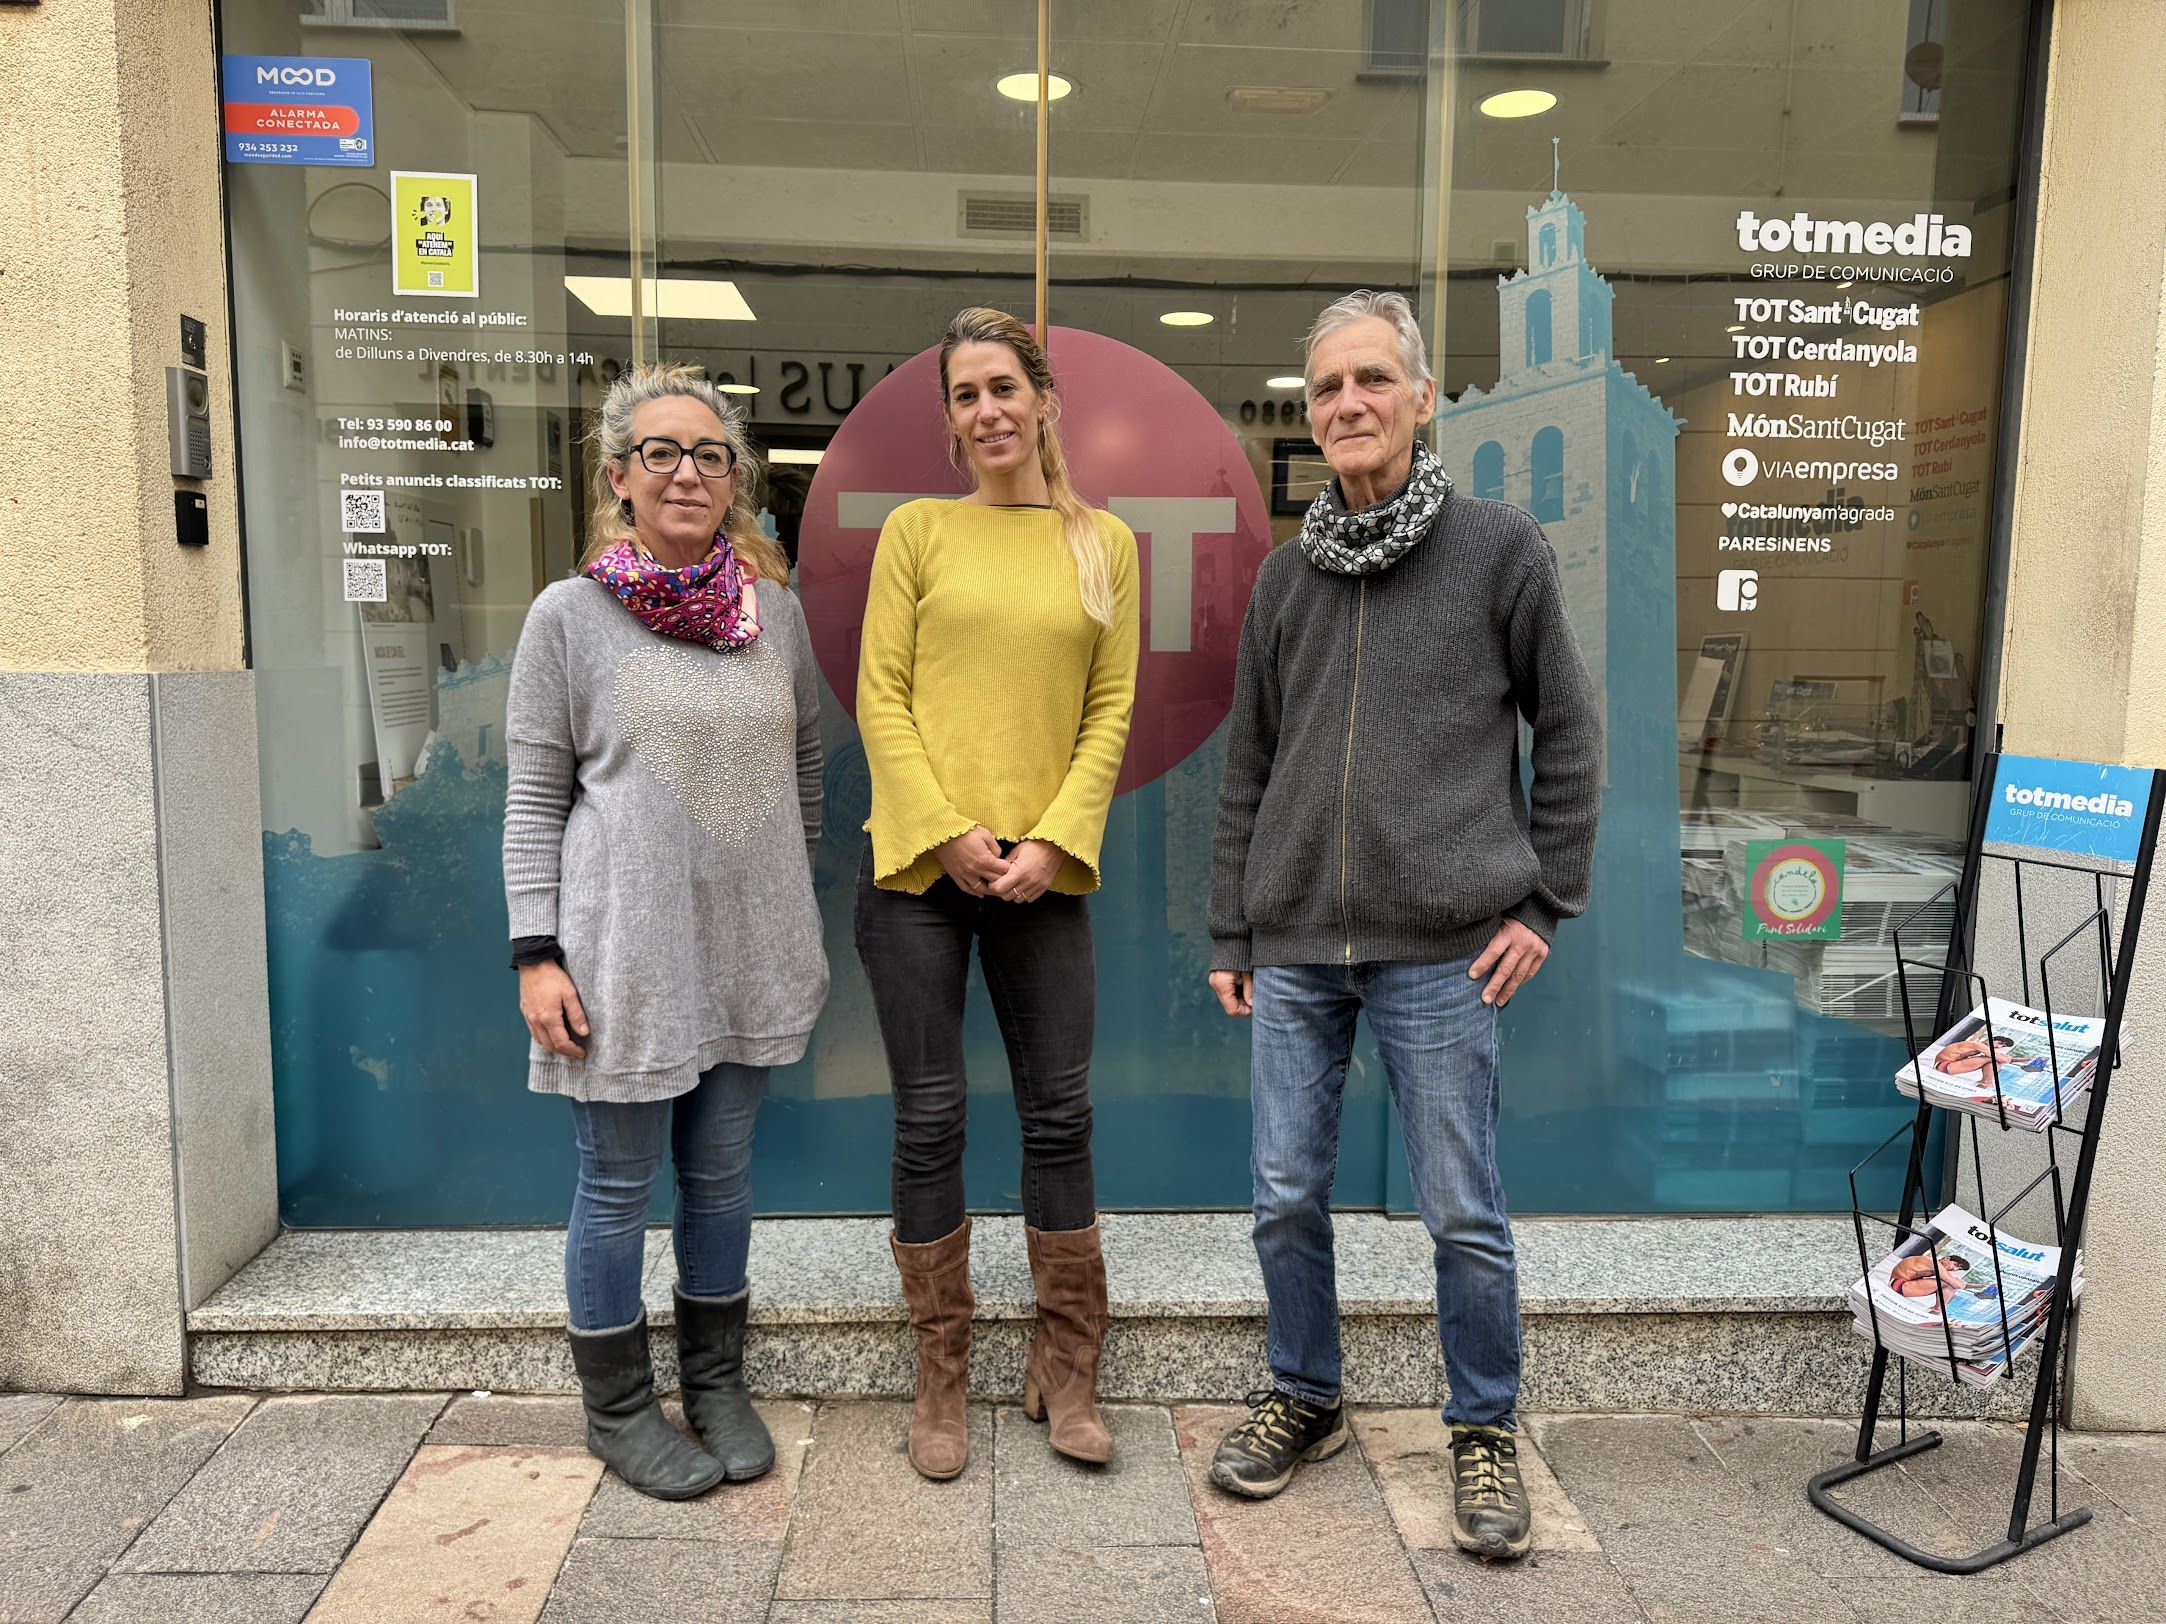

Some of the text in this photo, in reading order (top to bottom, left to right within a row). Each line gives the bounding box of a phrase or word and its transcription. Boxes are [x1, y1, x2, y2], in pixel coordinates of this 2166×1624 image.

[257, 66, 336, 86] MOOD
[270, 109, 326, 119] ALARMA
[256, 119, 341, 130] CONECTADA
[238, 143, 257, 152] 934
[260, 144, 278, 152] 253
[1736, 210, 1972, 257] totmedia
[419, 248, 453, 257] EN CATALÀ
[1750, 263, 1954, 283] GRUP DE COMUNICACIÓ
[334, 309, 527, 328] Horaris d'atenció al públic:
[1734, 298, 1920, 331] TOT Sant Cugat
[335, 328, 393, 341] MATINS:
[335, 346, 594, 365] de Dilluns a Divendres, de 8.30h a 14h
[1732, 335, 1917, 367] TOT Cerdanyola
[1730, 372, 1839, 398] TOT Rubí
[337, 417, 364, 431] Tel:
[367, 419, 384, 431] 93
[387, 420, 412, 431] 590
[415, 420, 433, 432] 86
[435, 420, 452, 432] 00
[1915, 419, 1935, 435] TOT
[1959, 406, 1987, 425] Cugat
[1727, 413, 1906, 448] MónSantCugat
[339, 435, 475, 451] info@totmedia.cat
[1914, 430, 1986, 457] TOT Cerdanyola
[1762, 460, 1898, 485] VIAempresa
[1911, 463, 1932, 479] TOT
[340, 473, 563, 490] Petits anuncis classificats TOT:
[343, 542, 452, 558] Whatsapp TOT:
[2005, 783, 2133, 817] totmedia
[2009, 808, 2121, 829] GRUP DE COMUNICACIÓ
[1785, 923, 1828, 935] Solidari
